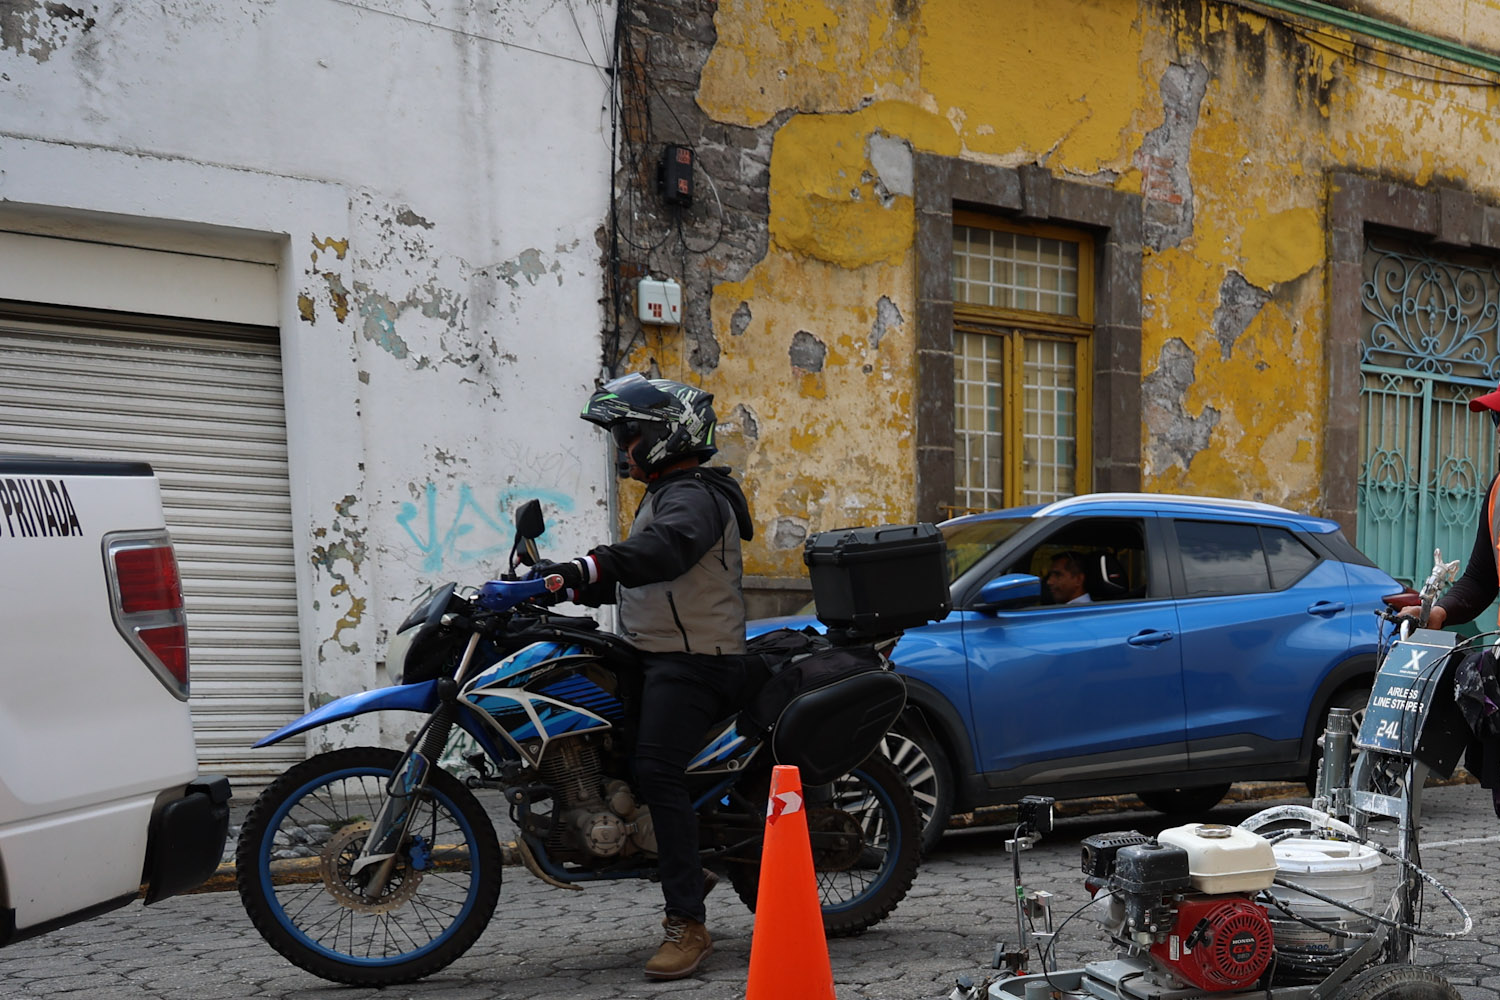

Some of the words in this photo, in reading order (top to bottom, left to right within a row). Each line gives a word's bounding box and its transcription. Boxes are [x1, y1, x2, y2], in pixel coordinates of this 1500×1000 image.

[0, 478, 83, 537] PRIVADA
[1387, 686, 1419, 700] AIRLESS
[1373, 696, 1391, 708] LINE
[1391, 698, 1424, 714] STRIPER
[1376, 719, 1400, 740] 24L
[1232, 937, 1255, 945] HONDA
[1233, 944, 1254, 954] GX
